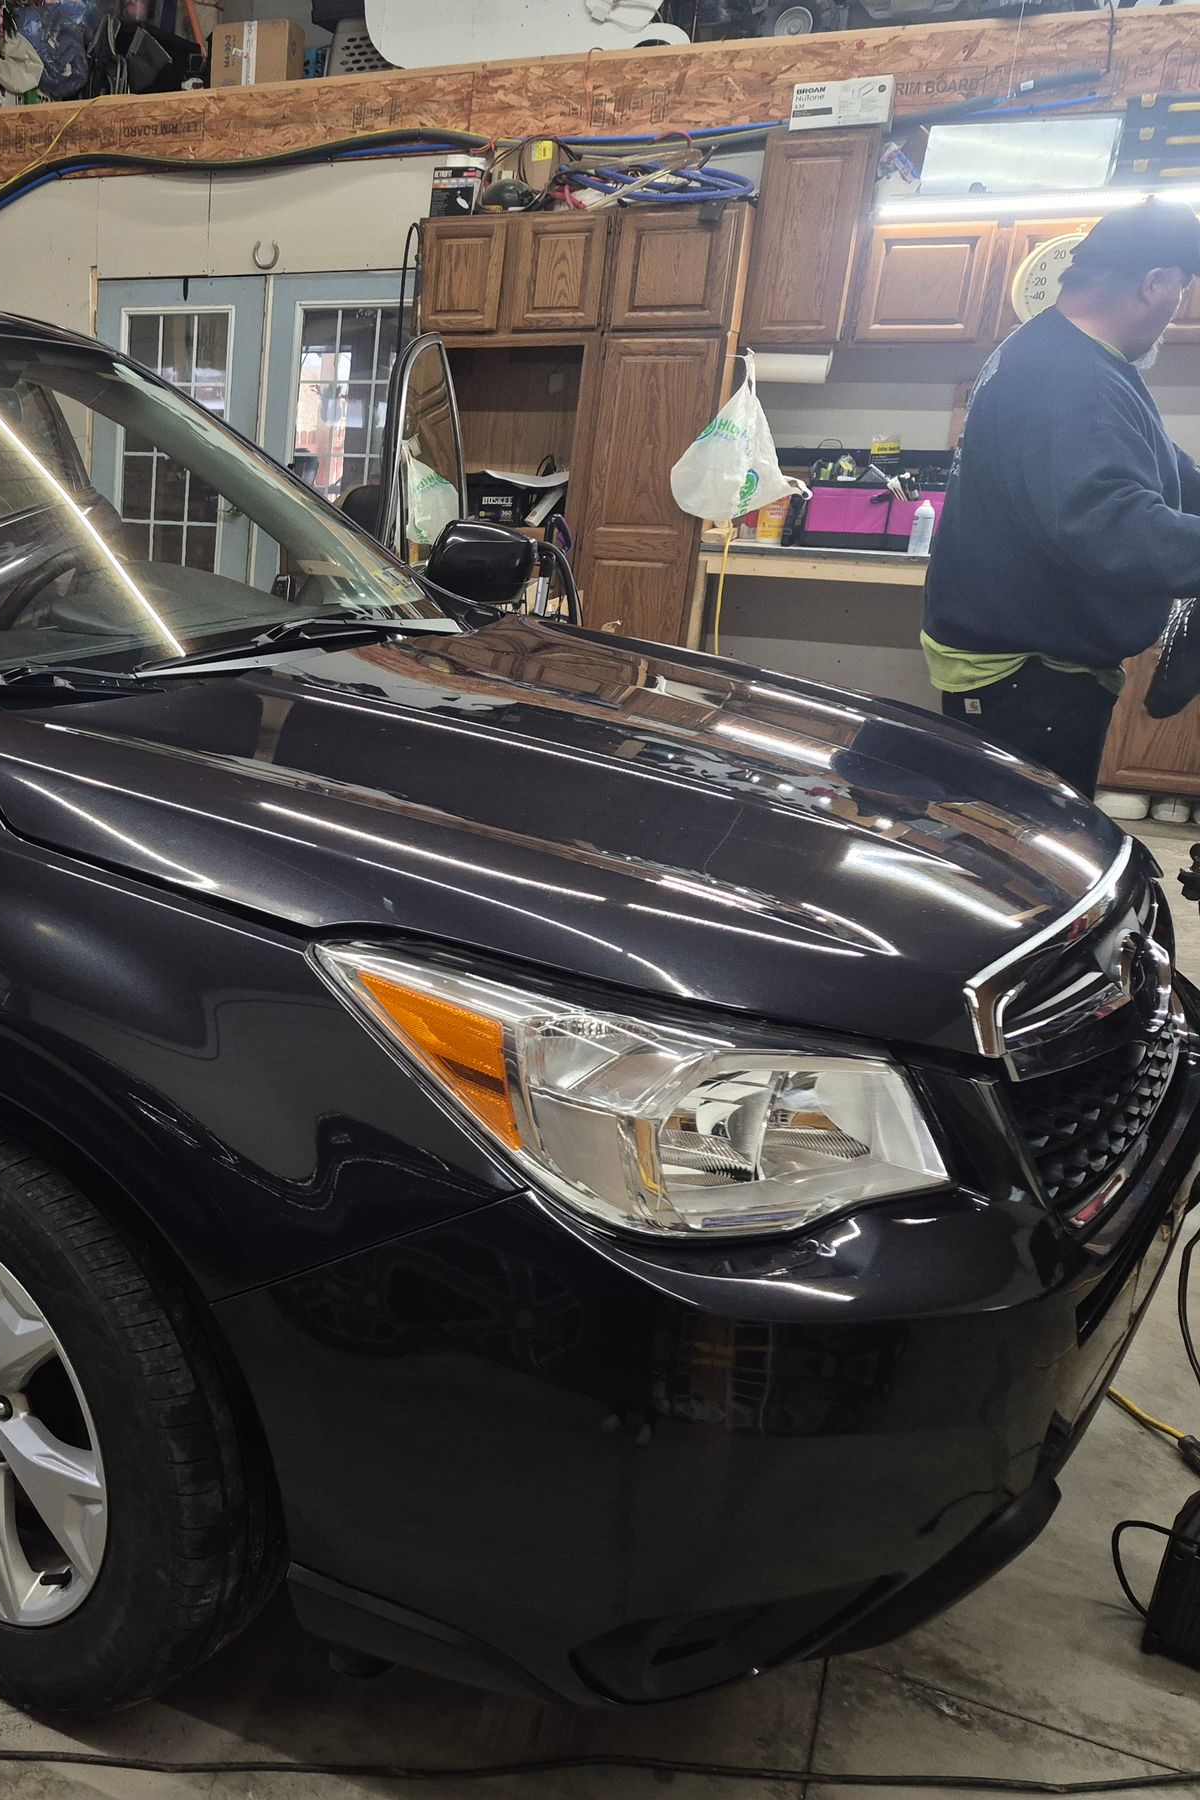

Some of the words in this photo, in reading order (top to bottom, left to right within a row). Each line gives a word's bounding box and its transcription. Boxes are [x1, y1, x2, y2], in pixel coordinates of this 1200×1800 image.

[796, 86, 826, 95] BROAN
[896, 80, 922, 97] RIM
[925, 77, 980, 94] BOARD
[795, 94, 825, 103] NuTone
[123, 123, 159, 138] BOARD
[1053, 250, 1067, 260] 20
[1040, 262, 1047, 271] 0
[1032, 277, 1047, 287] -20
[1029, 291, 1045, 301] -40
[481, 496, 513, 505] HUSKEE
